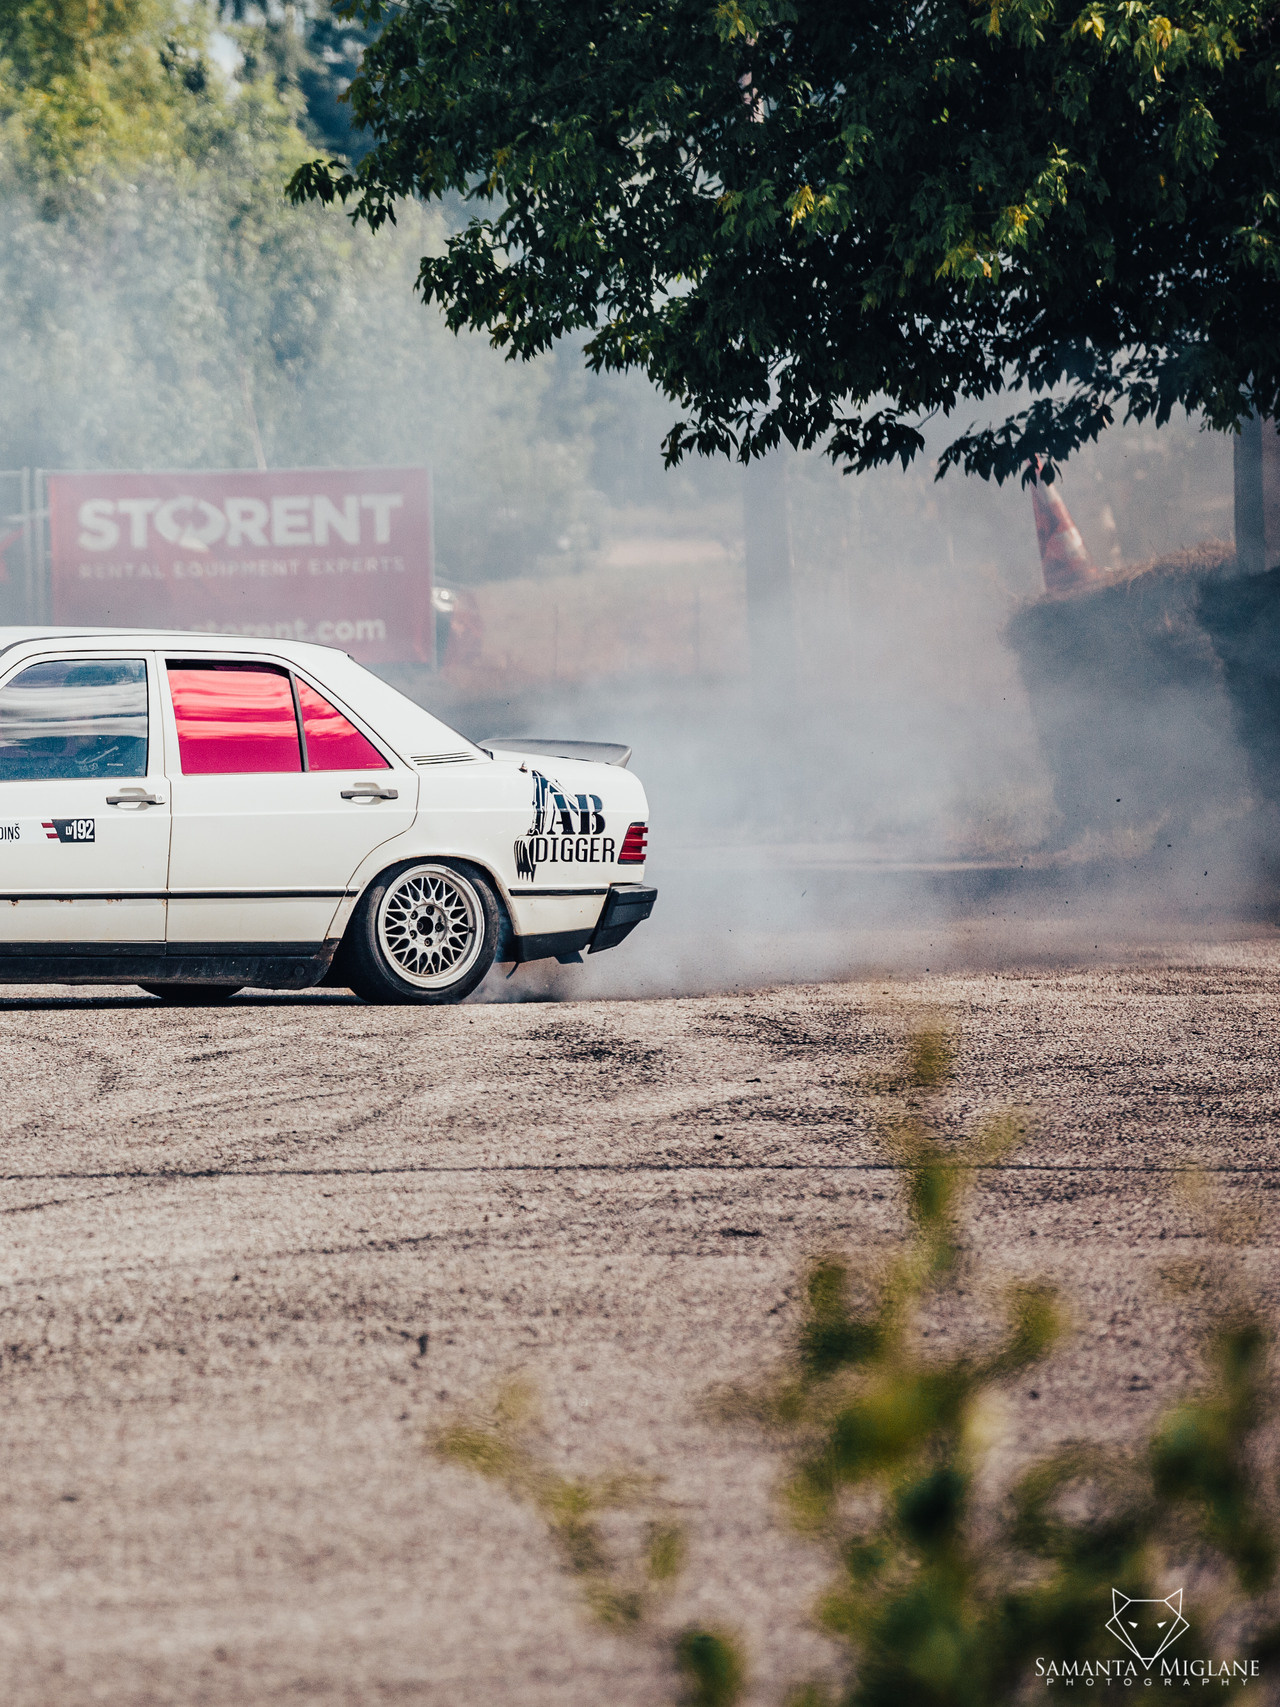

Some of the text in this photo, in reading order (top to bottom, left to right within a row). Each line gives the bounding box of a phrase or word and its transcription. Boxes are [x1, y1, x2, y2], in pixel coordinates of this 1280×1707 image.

[78, 494, 404, 552] STORENT
[79, 556, 406, 580] RENTAL EQUIPMENT EXPERTS
[535, 837, 616, 863] DIGGER
